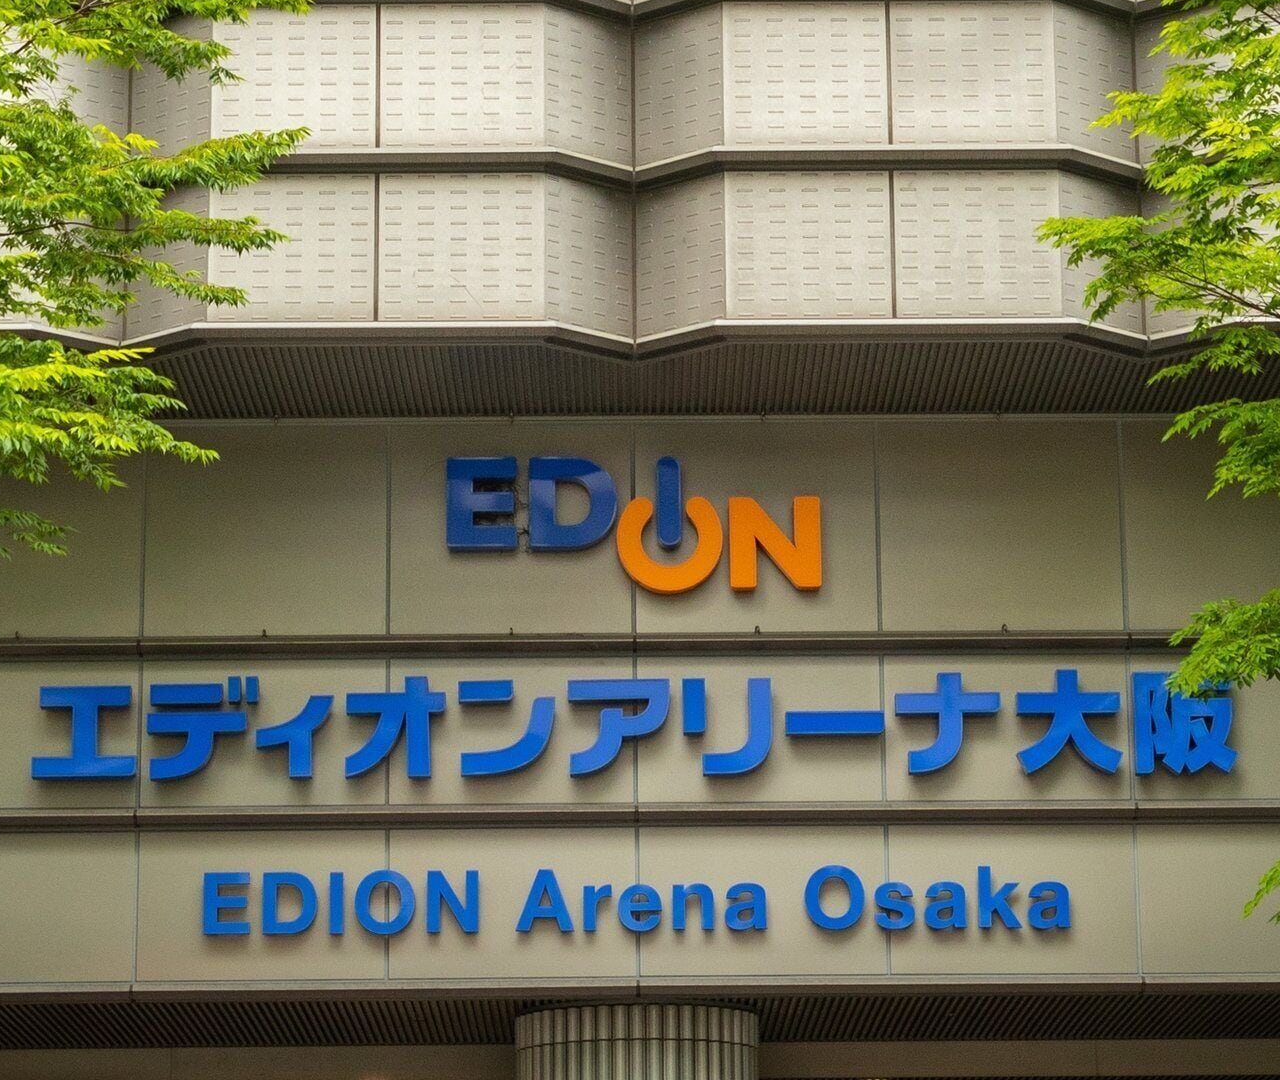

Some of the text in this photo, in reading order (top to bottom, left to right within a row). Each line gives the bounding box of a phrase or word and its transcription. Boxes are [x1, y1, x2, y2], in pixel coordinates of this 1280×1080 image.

[445, 455, 824, 594] EDION
[30, 668, 1239, 782] エディオンアリーナ大阪
[200, 864, 1073, 937] EDION Arena Osaka
